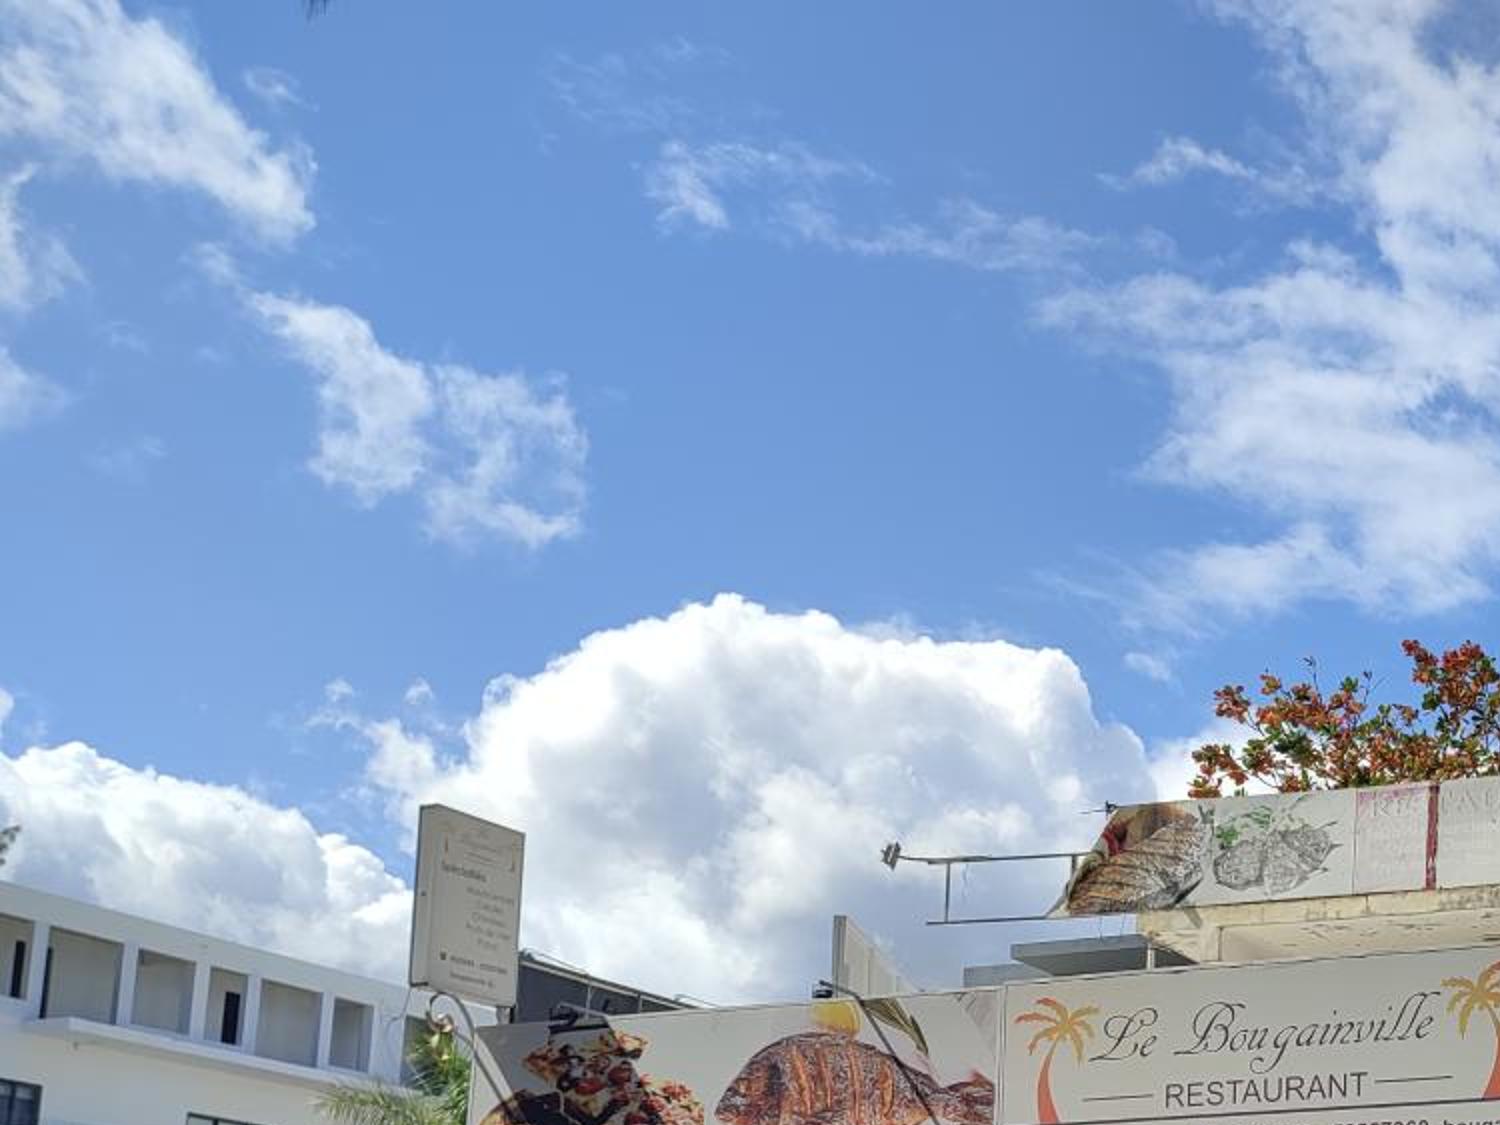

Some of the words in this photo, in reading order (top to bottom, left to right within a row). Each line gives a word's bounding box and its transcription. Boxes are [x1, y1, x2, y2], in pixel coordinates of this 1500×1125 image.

[1089, 1008, 1159, 1063] Le
[1173, 990, 1442, 1075] Bougainville
[1164, 1071, 1369, 1110] RESTAURANT
